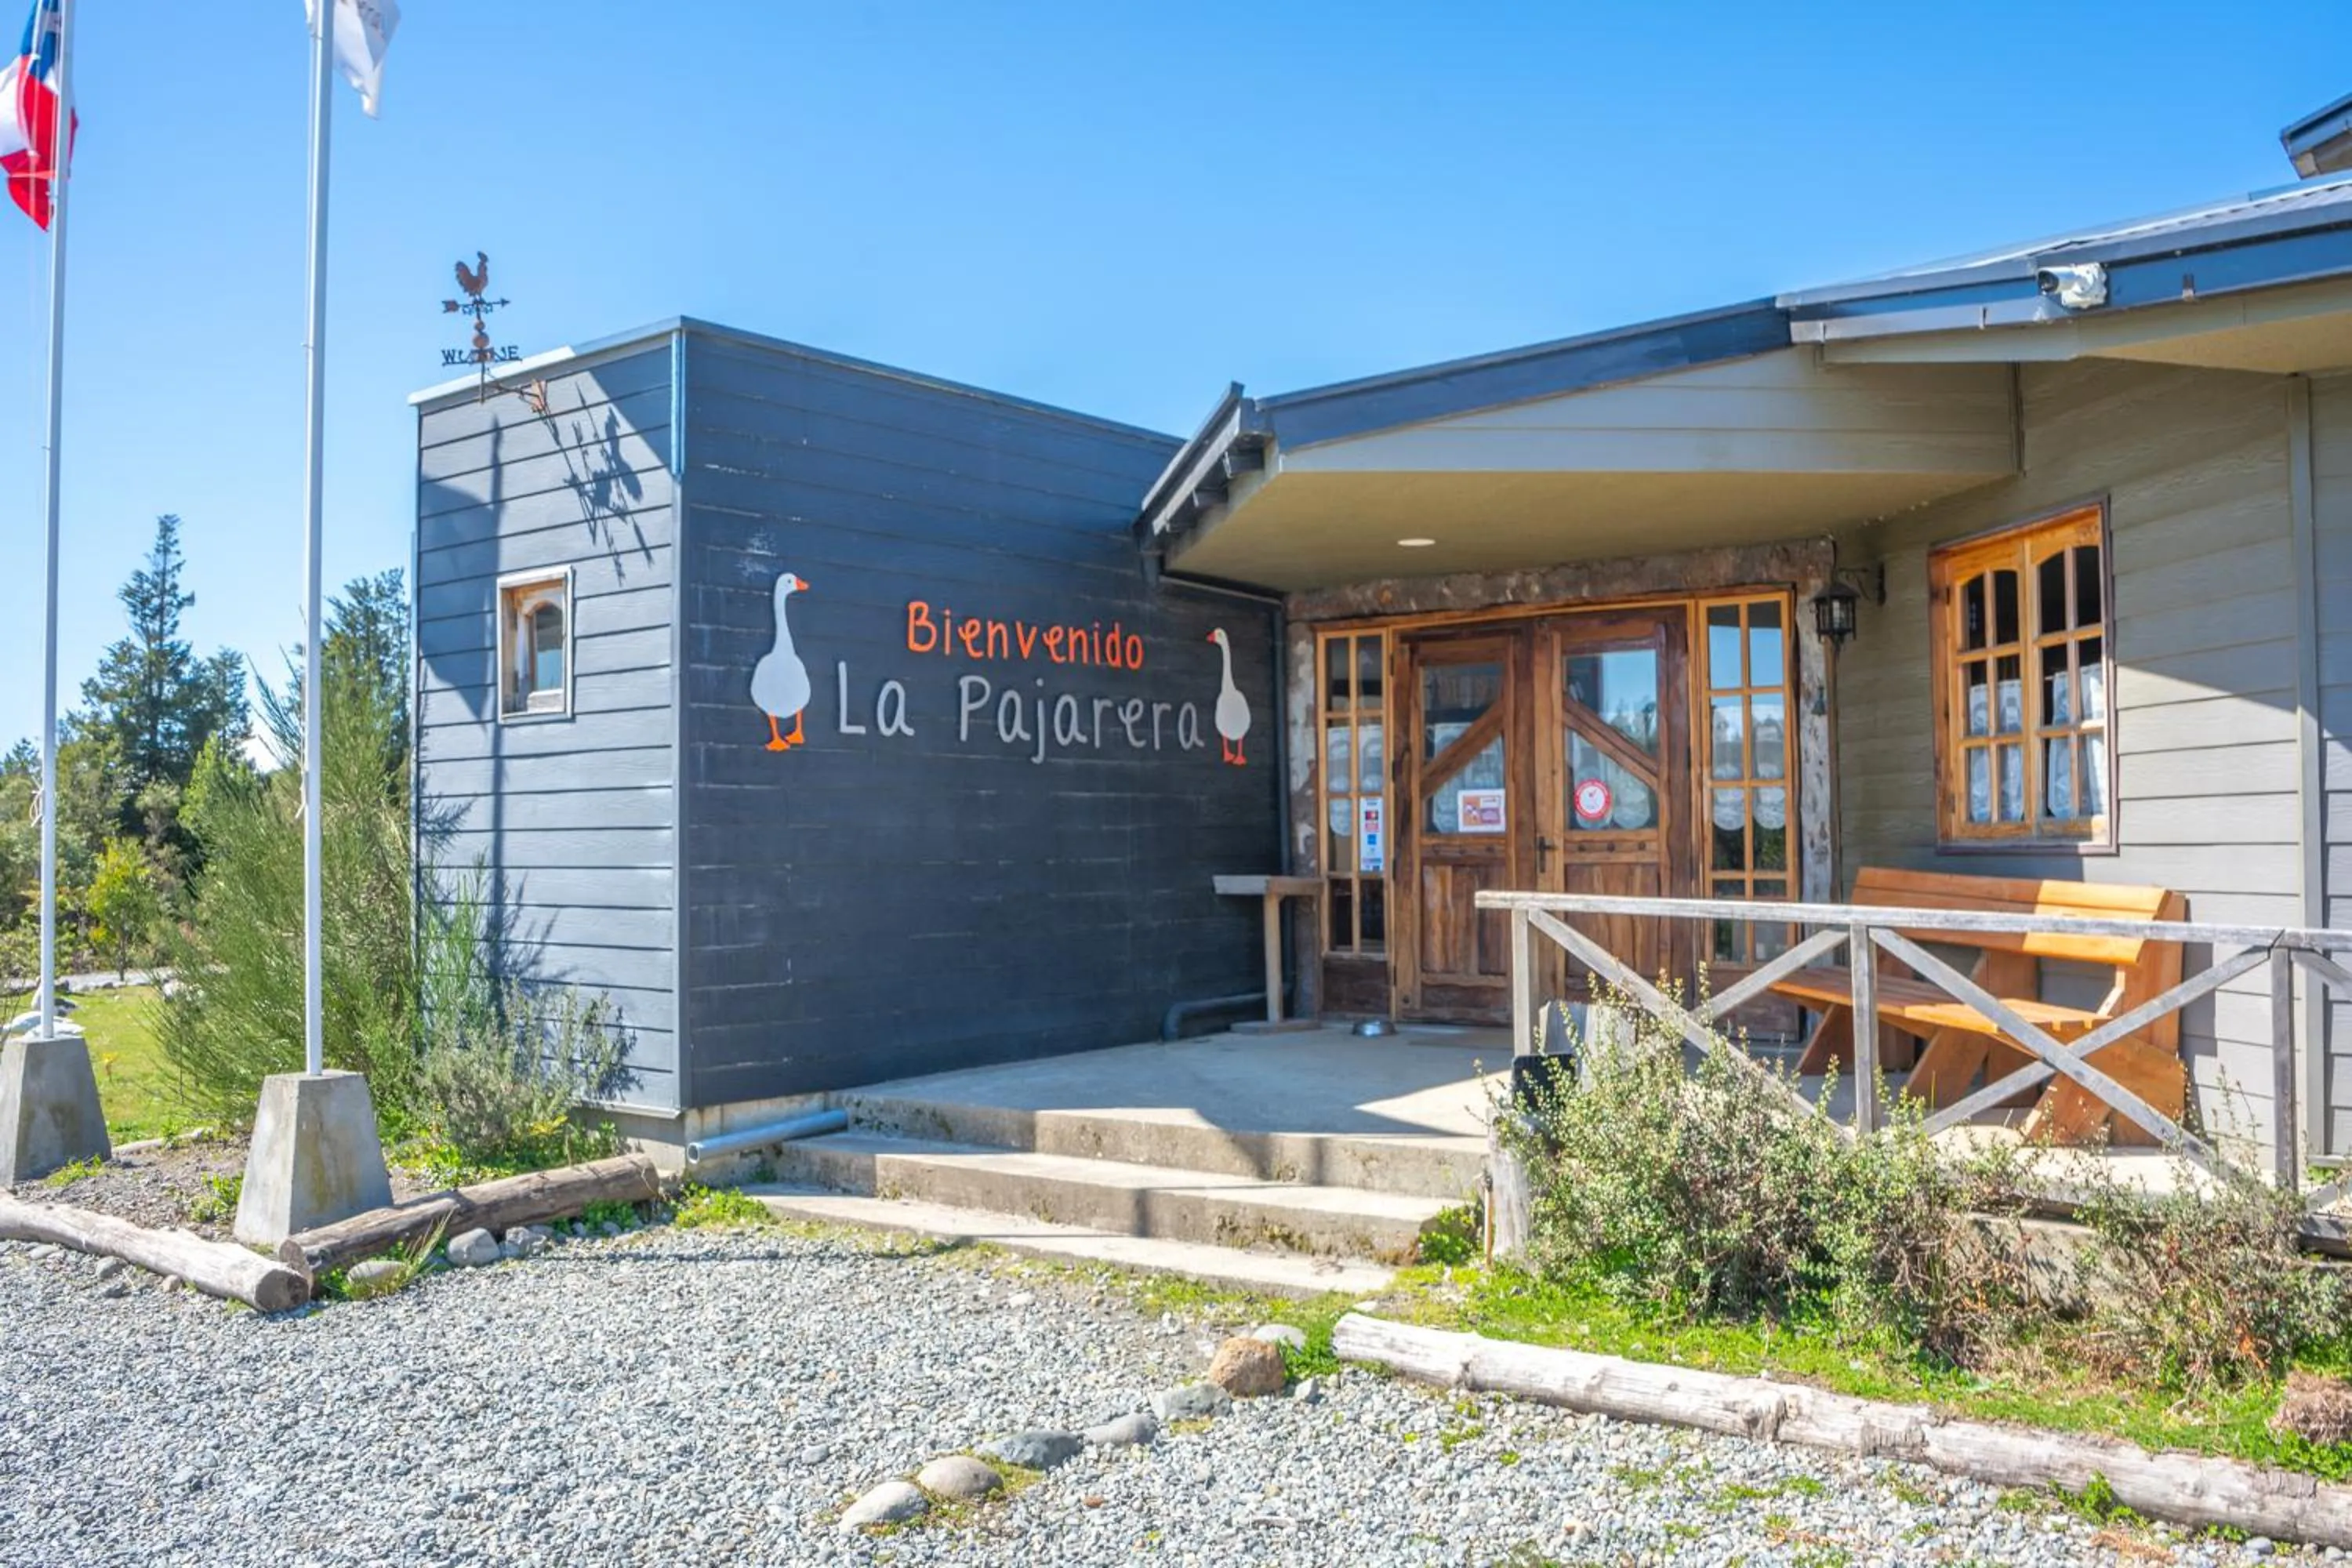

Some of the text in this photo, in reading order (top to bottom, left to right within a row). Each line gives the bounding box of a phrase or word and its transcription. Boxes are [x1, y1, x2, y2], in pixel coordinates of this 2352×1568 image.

[908, 601, 1143, 669] Bienvenido
[837, 660, 1205, 764] La Pajarera
